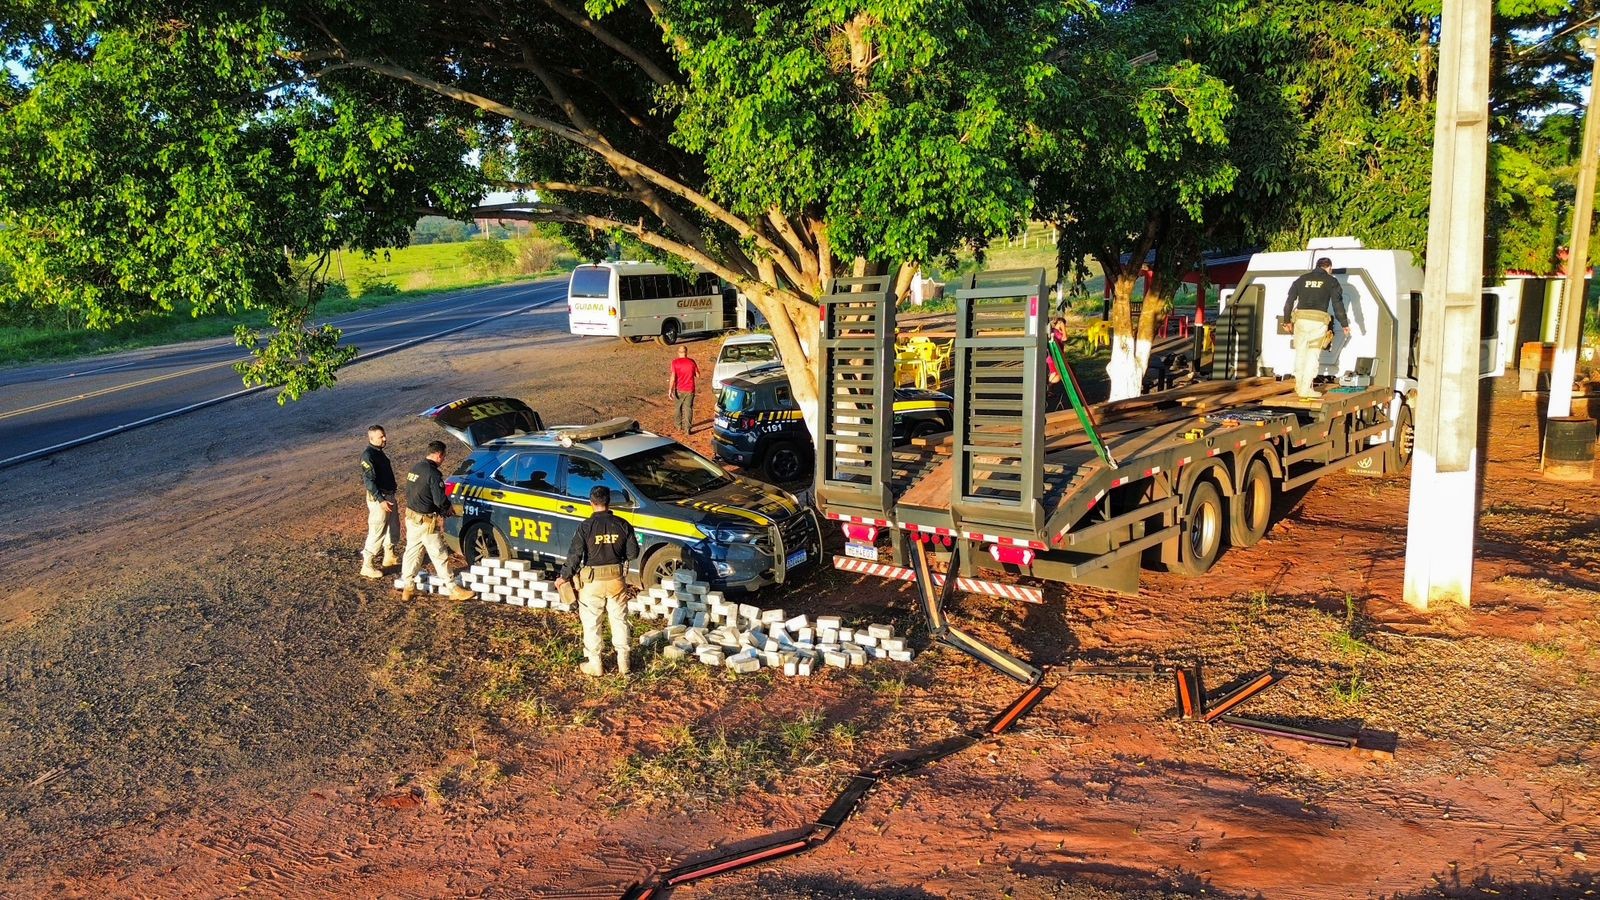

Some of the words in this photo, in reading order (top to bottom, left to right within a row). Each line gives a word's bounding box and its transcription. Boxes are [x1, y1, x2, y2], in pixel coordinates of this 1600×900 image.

[1304, 280, 1323, 288] PRF
[574, 303, 604, 311] GUIANA
[677, 298, 712, 308] GUIANA
[767, 424, 782, 433] 191
[407, 472, 419, 482] PRF
[465, 505, 478, 516] 191
[509, 516, 552, 543] PRF
[595, 534, 619, 544] PRF
